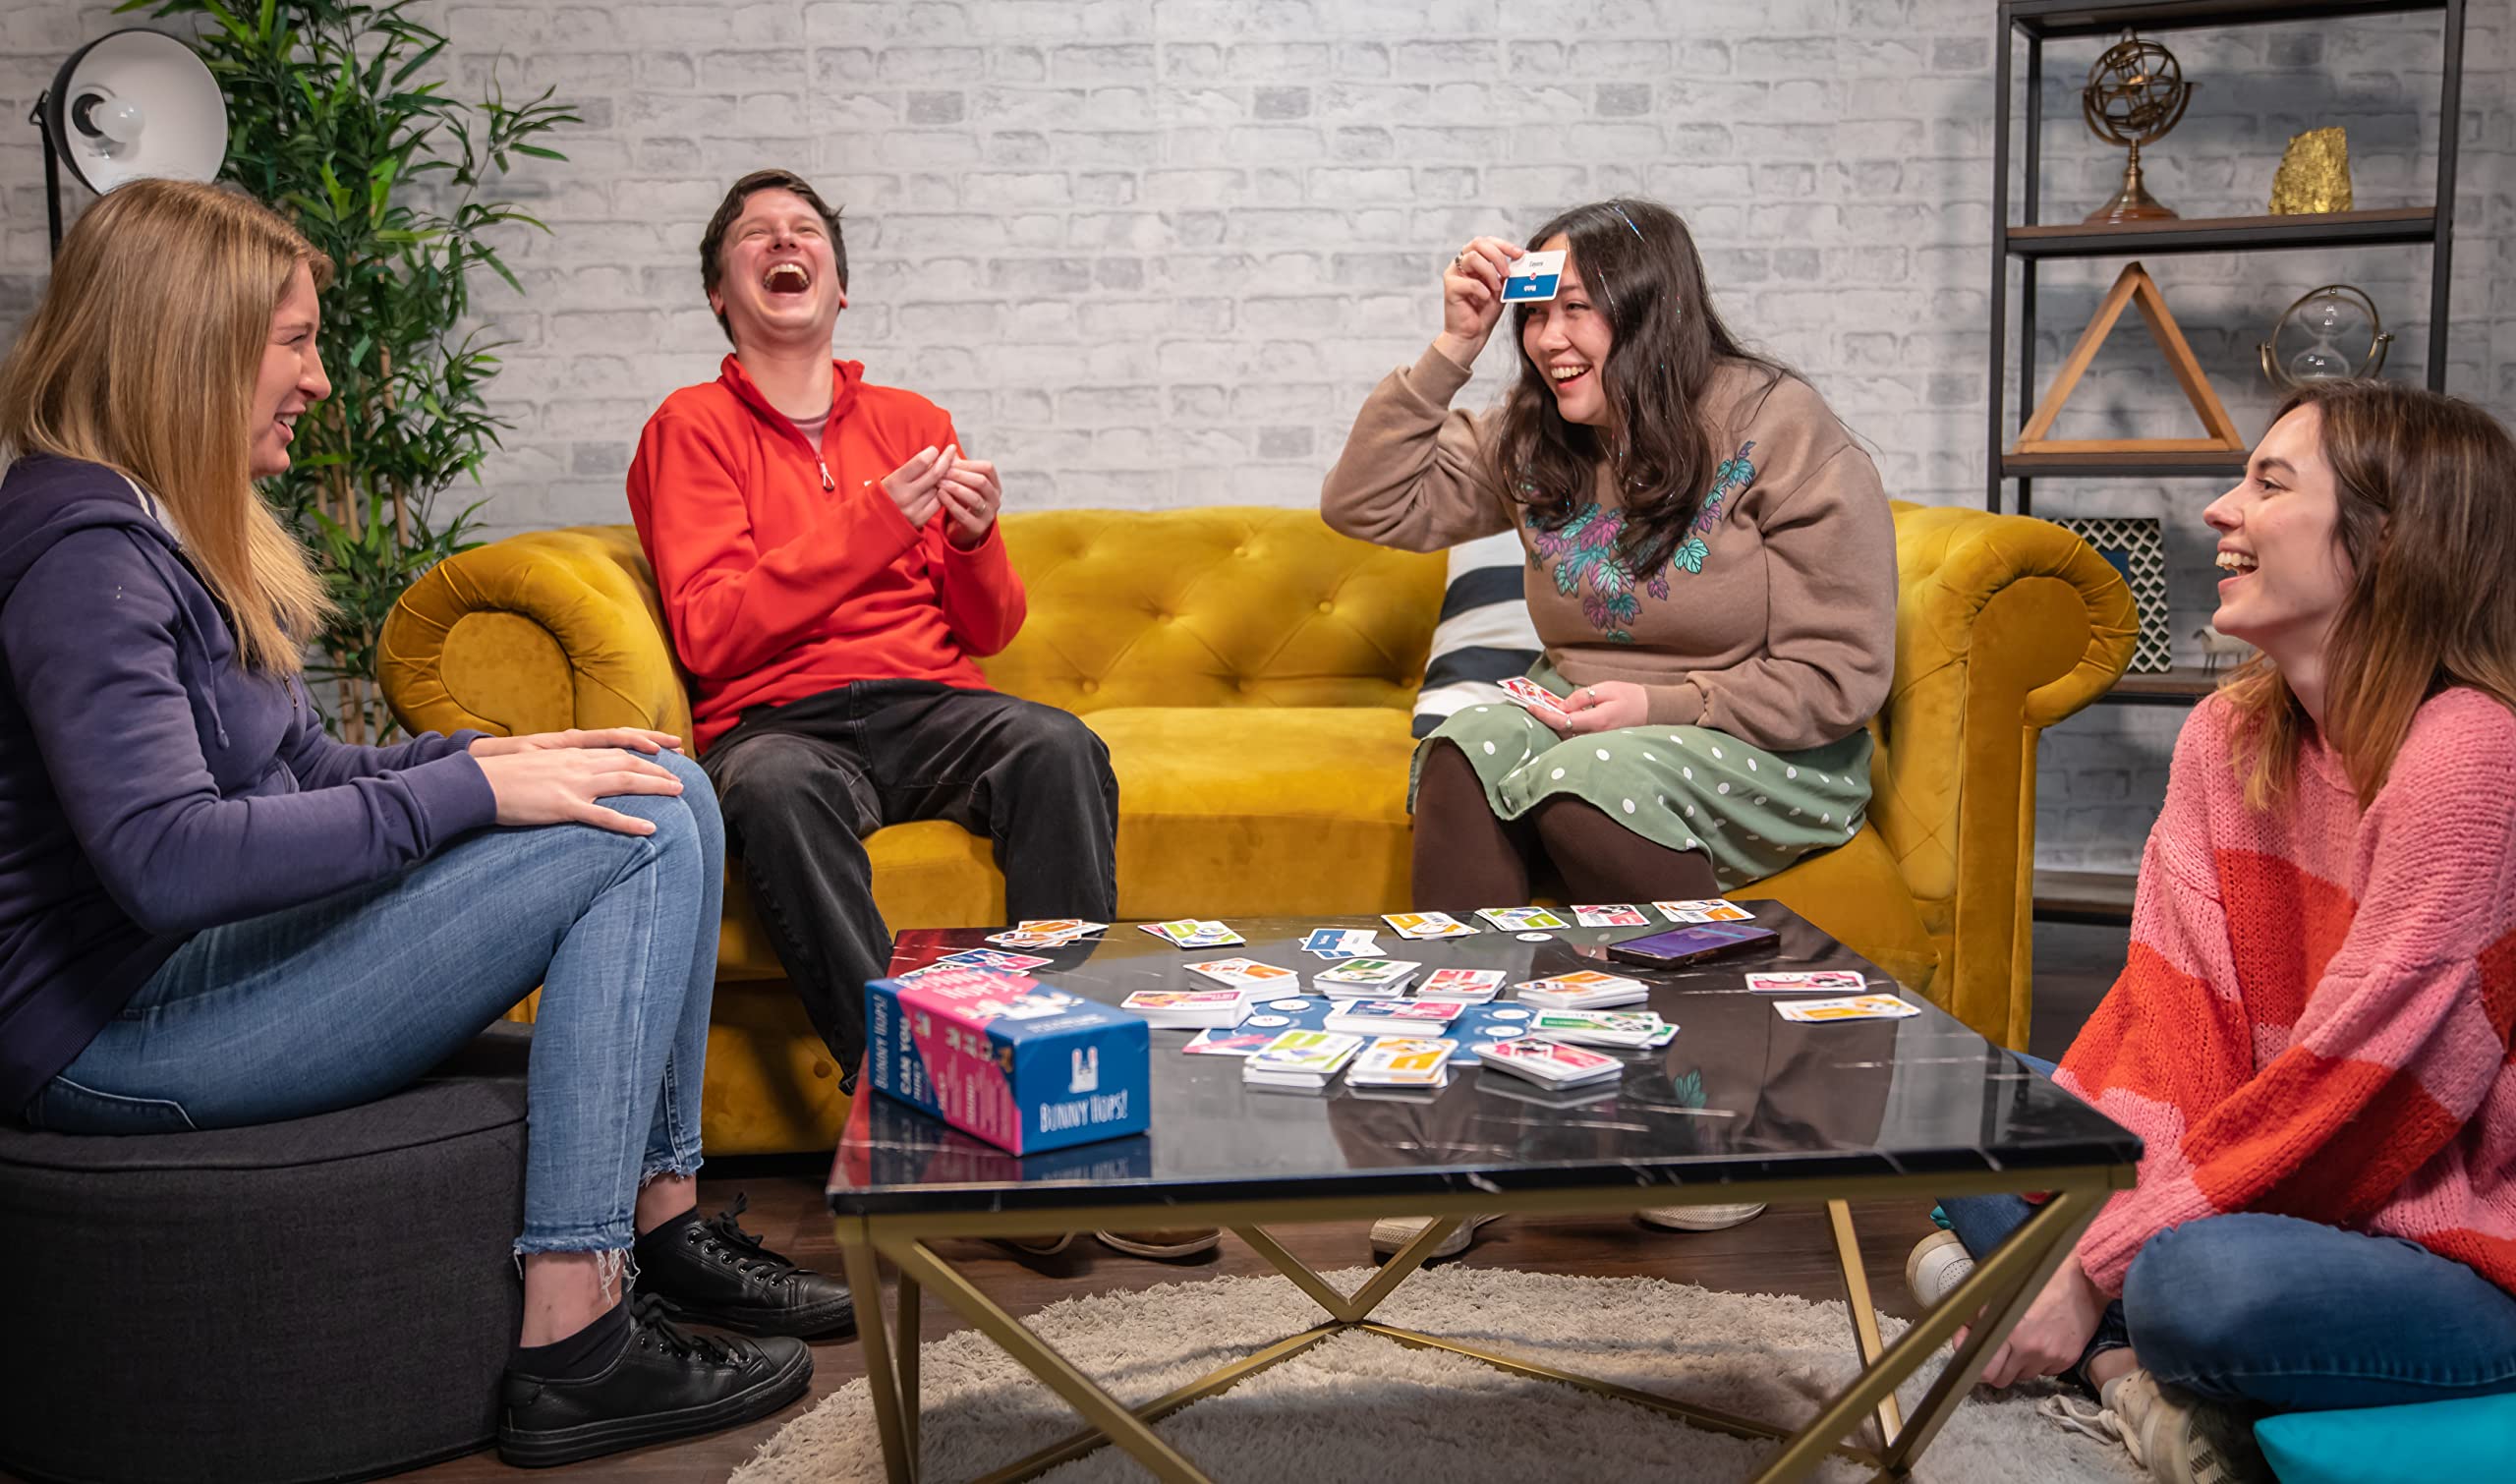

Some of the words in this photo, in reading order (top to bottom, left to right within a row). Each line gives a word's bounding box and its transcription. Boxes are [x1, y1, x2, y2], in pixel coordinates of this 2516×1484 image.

[872, 993, 888, 1037] HOPS!
[898, 1016, 912, 1053] YOU
[875, 1036, 888, 1090] BUNNY
[899, 1056, 912, 1095] CAN
[1040, 1099, 1089, 1132] BUNNY
[1090, 1088, 1128, 1123] HOPS!
